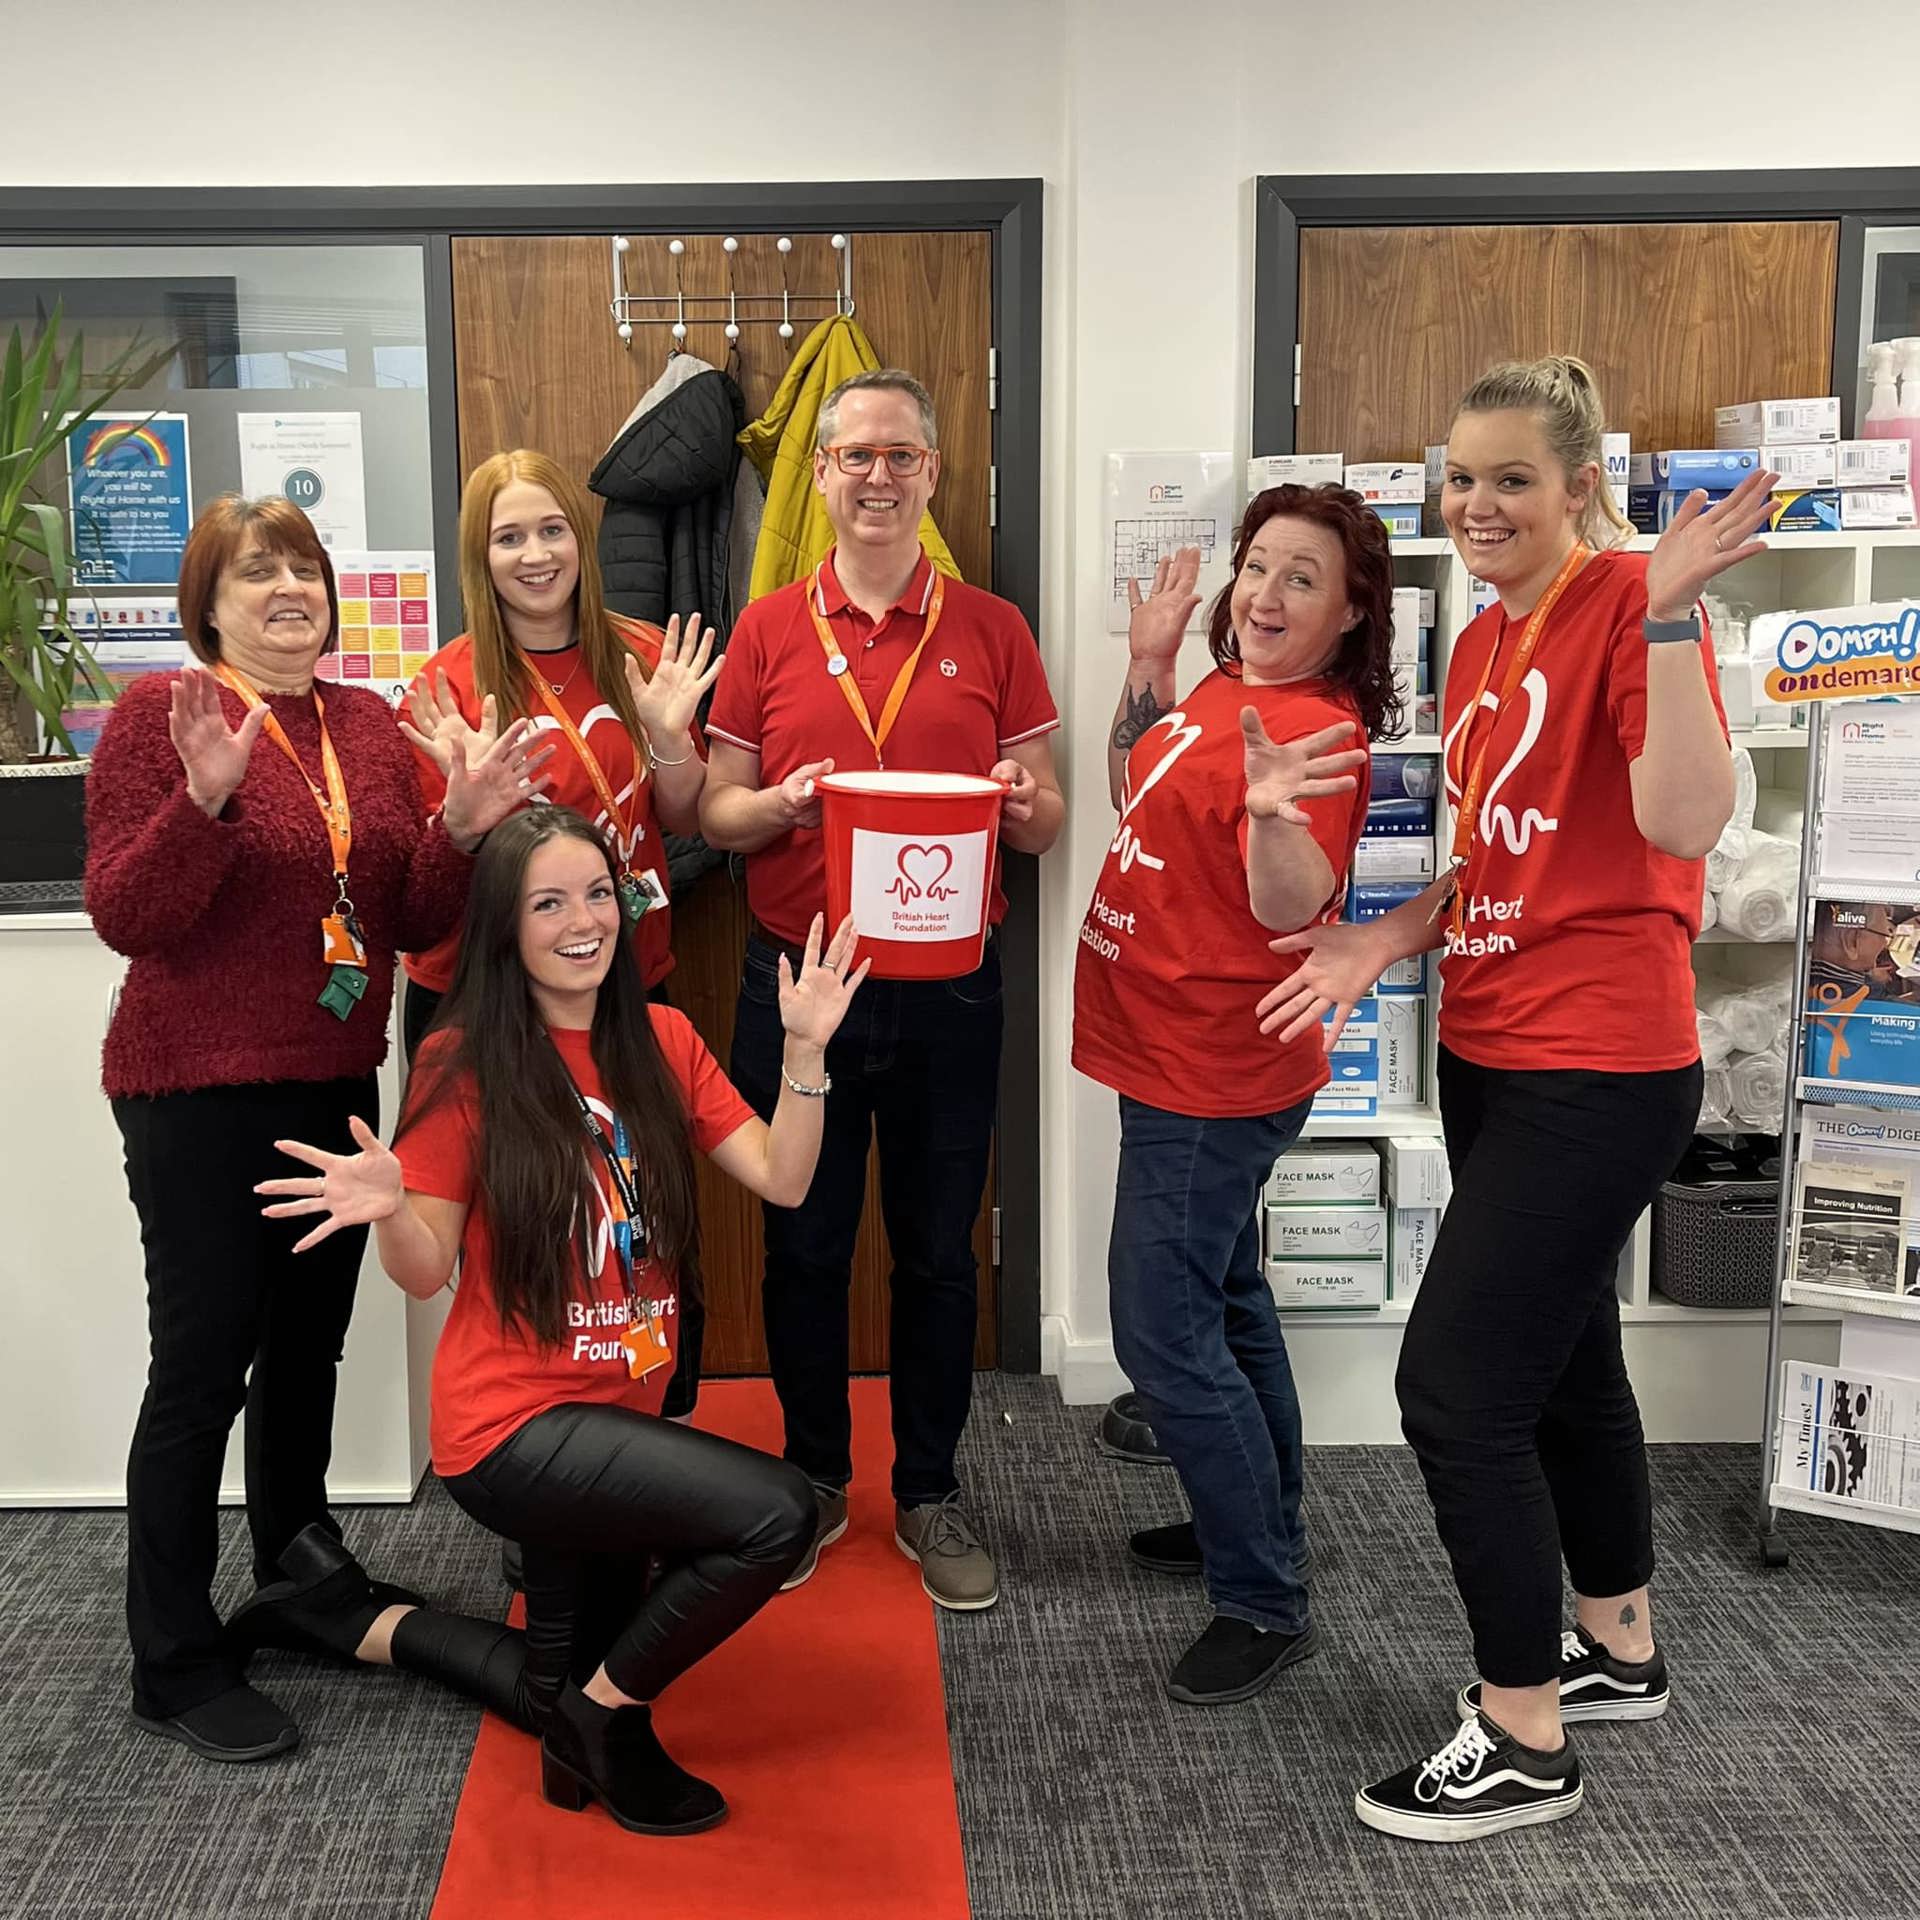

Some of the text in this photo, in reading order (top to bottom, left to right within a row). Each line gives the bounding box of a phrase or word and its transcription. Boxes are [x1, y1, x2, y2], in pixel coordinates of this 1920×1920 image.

[1609, 456, 1626, 473] M
[130, 470, 148, 480] you
[104, 482, 153, 493] you will be
[294, 479, 314, 496] 10
[80, 495, 181, 506] Right at Home with us
[108, 510, 129, 519] safe
[153, 511, 169, 520] you
[1420, 858, 1432, 873] L
[892, 911, 950, 922] British Heart
[1092, 892, 1136, 935] Heart
[1837, 911, 1867, 925] alive
[894, 922, 947, 933] Foundation
[1871, 1016, 1916, 1031] Making
[1389, 1038, 1399, 1094] FACE MASK
[1817, 1121, 1846, 1135] THE
[1277, 1172, 1335, 1182] FACE MASK
[1814, 1196, 1894, 1214] Improving Nutrition
[1282, 1226, 1341, 1236] FACE MASK
[1415, 1220, 1424, 1276] FACE MASK
[1296, 1276, 1354, 1286] FACE MASK
[567, 1297, 632, 1328] British
[1796, 1402, 1813, 1469] My Times!
